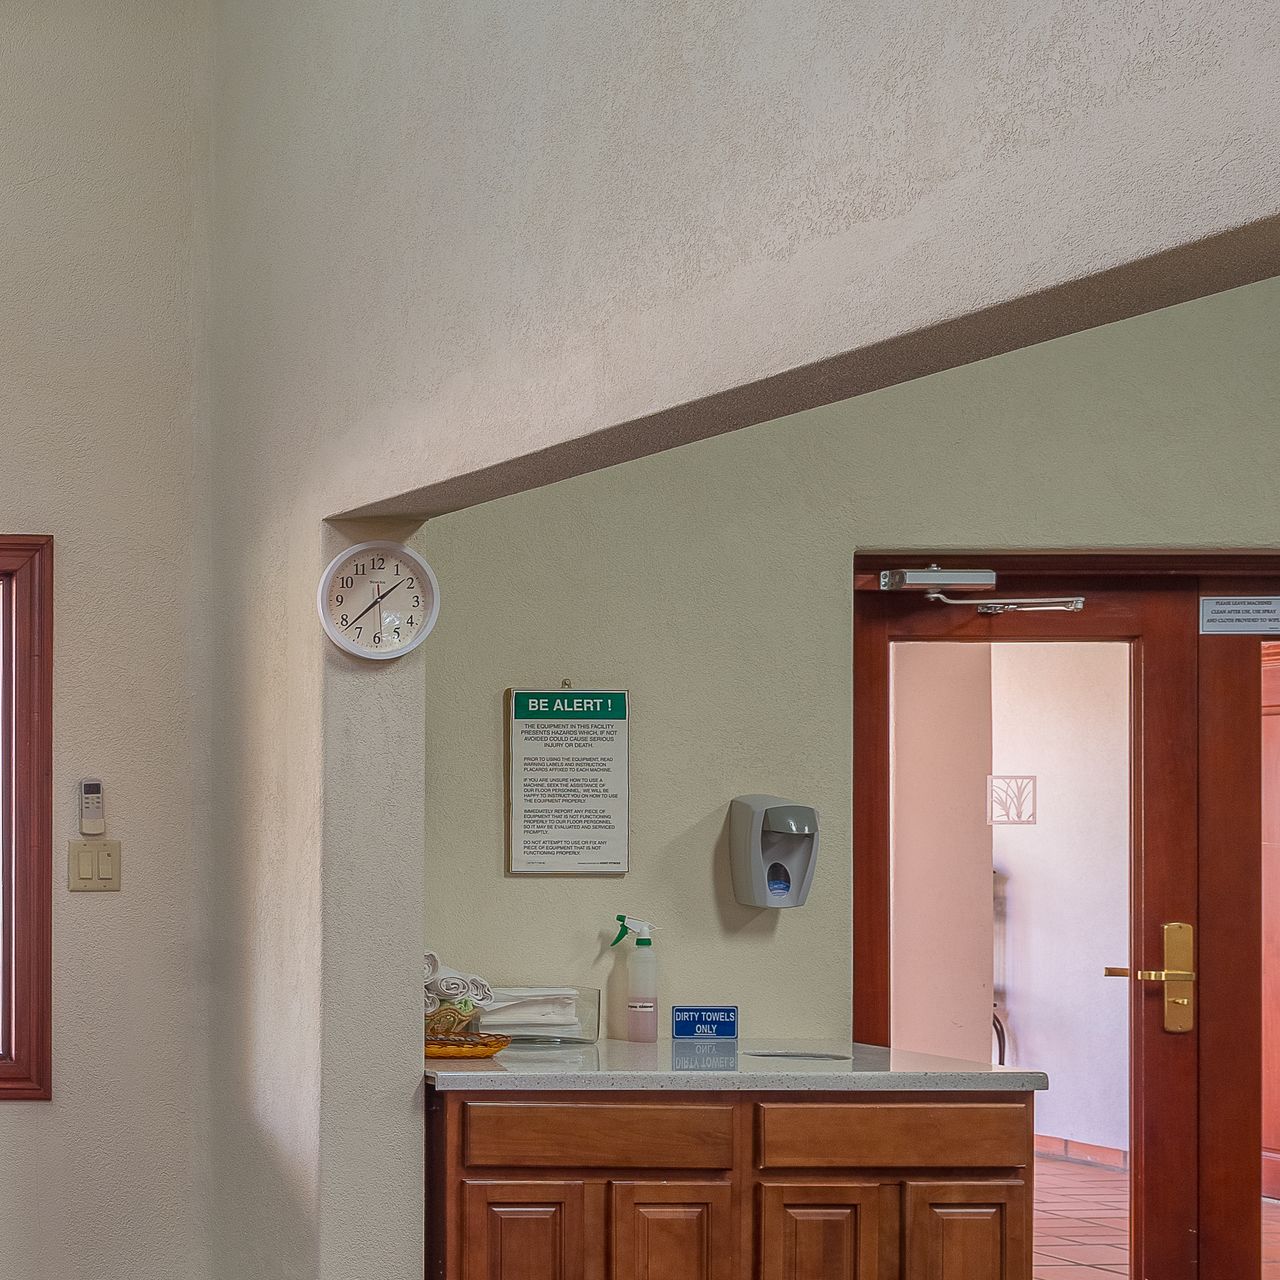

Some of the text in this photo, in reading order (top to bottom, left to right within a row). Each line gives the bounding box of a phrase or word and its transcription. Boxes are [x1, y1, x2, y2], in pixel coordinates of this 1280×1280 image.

[370, 558, 385, 569] 12
[354, 564, 366, 575] 11
[394, 564, 400, 575] 1
[340, 576, 353, 588] 10
[407, 578, 414, 589] 2
[336, 595, 343, 607] 9
[412, 596, 419, 607] 3
[341, 614, 348, 626] 8
[407, 615, 414, 626] 4
[355, 627, 362, 638] 7
[373, 632, 380, 643] 6
[393, 627, 400, 639] 5
[528, 699, 548, 711] BE
[553, 699, 603, 711] ALERT
[676, 1012, 735, 1021] DIRTY TOWELS
[695, 1024, 717, 1034] ONLY
